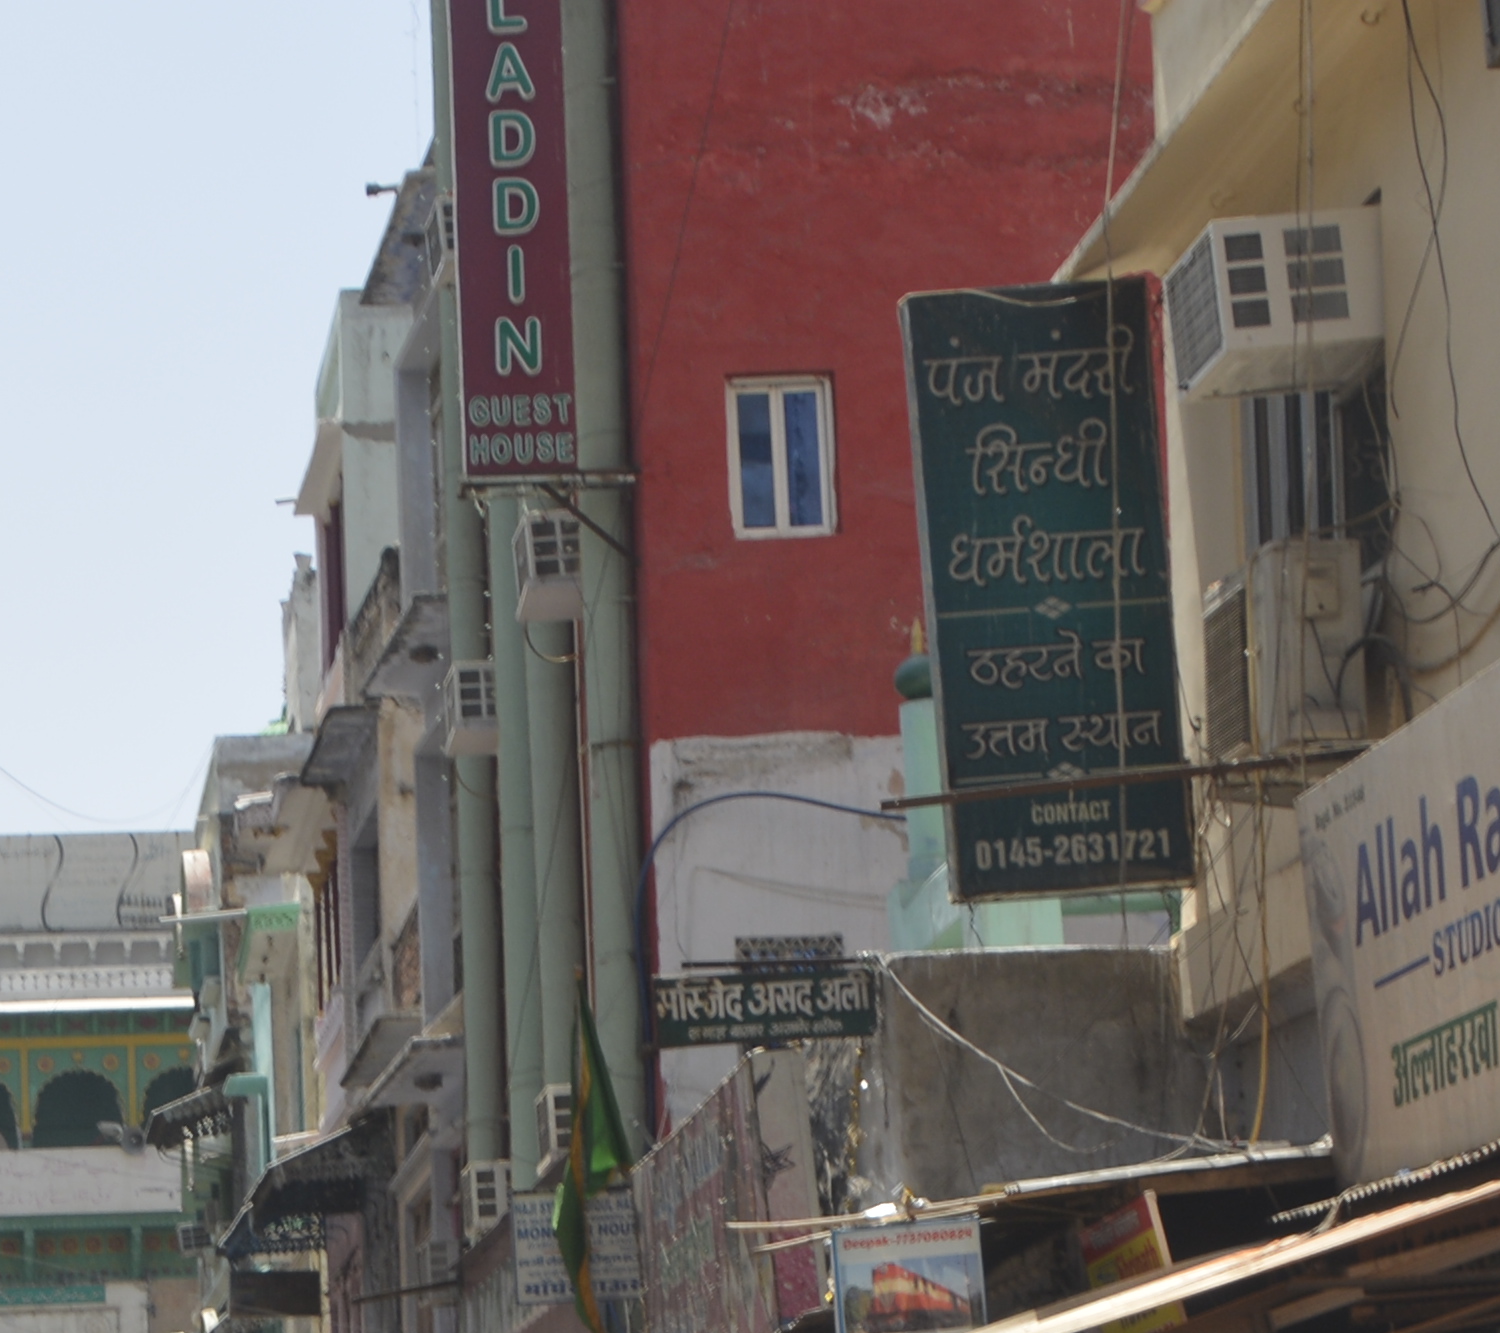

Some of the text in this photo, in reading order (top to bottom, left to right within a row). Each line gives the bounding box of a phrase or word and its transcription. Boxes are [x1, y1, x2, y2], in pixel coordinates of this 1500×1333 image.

[469, 393, 572, 427] GUEST
[469, 432, 575, 465] HOUSE
[965, 417, 1109, 496] सिन्धी
[949, 514, 1147, 587] धर्मशाला
[967, 627, 1146, 689] ठहरने का
[961, 709, 1162, 760] उत्तम स्थान
[1031, 800, 1112, 825] CONTACT
[974, 827, 1172, 872] 0145-2631721
[1355, 795, 1446, 948] Allah
[748, 979, 815, 1016] असद
[816, 974, 872, 1012] अली
